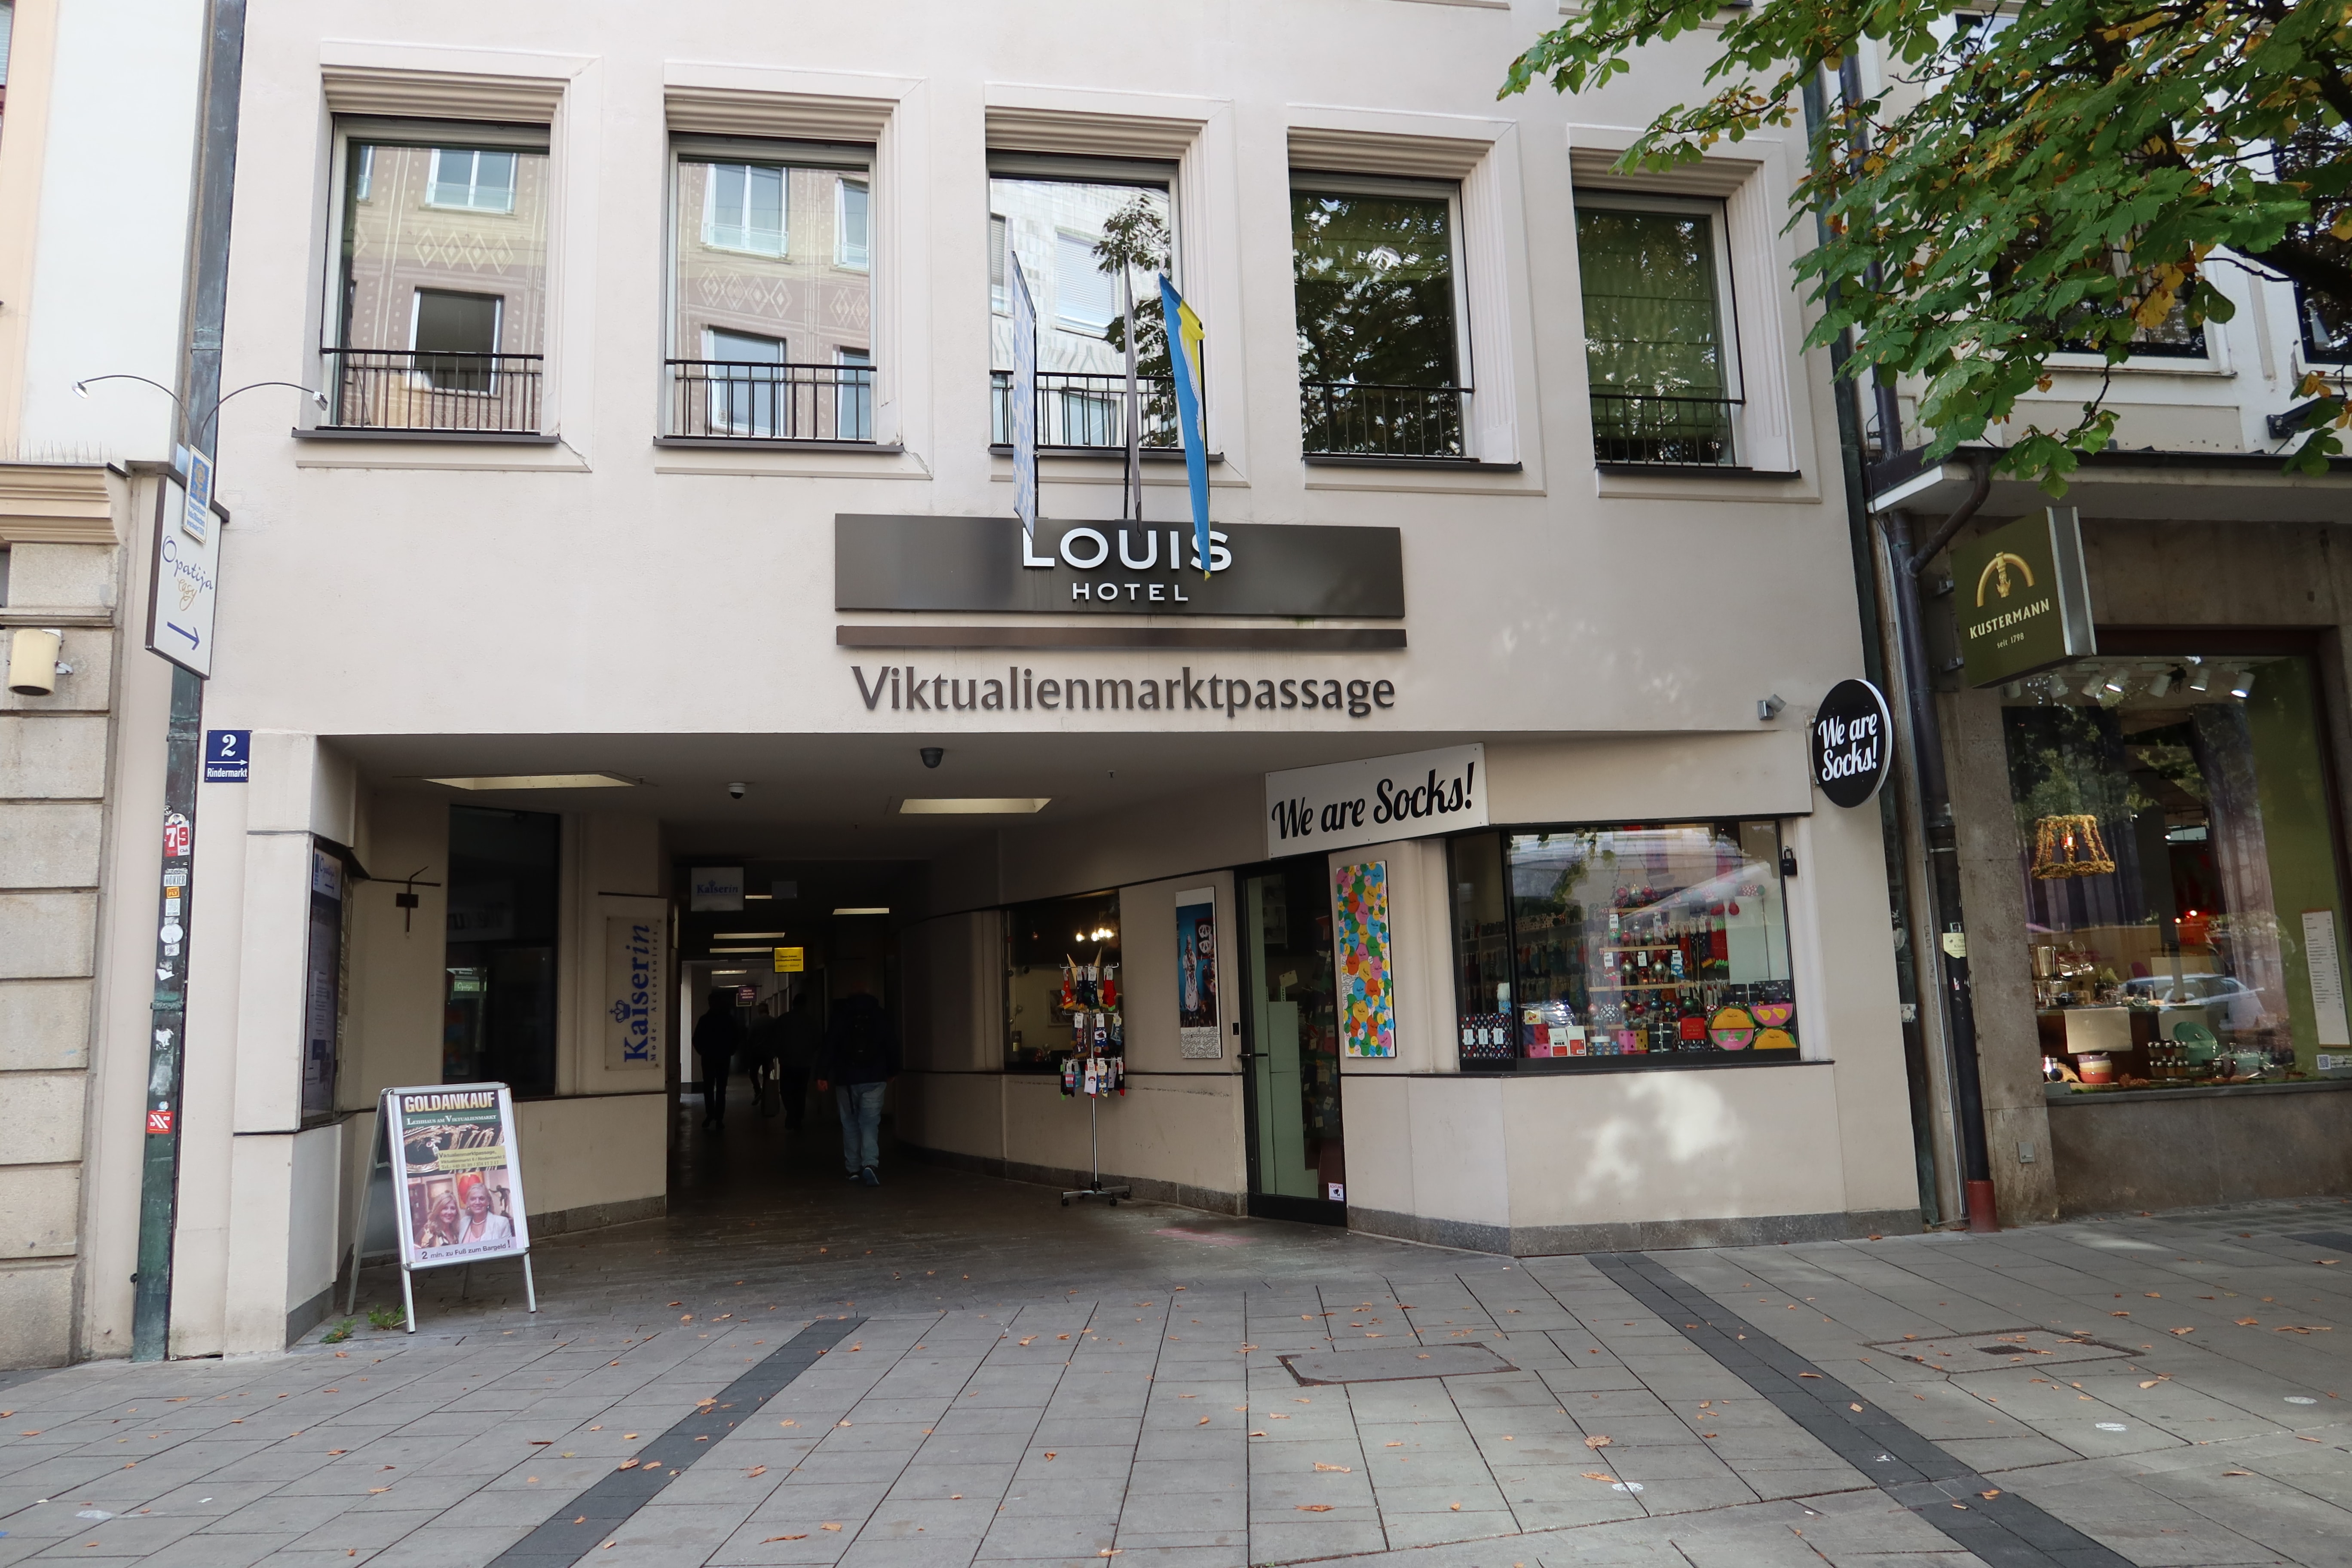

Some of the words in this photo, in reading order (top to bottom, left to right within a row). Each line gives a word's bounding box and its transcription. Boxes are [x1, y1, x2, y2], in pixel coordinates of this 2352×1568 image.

[1023, 527, 1232, 572] LOUIS
[162, 536, 214, 594] Opatija
[1072, 582, 1189, 601] HOTEL
[1969, 598, 2050, 640] KUSTERMANN
[1997, 639, 2008, 649] seit
[2010, 632, 2024, 644] 1798
[850, 666, 1396, 718] Viktualienmarktpassage
[221, 734, 236, 757] 2
[1818, 715, 1845, 749] We
[1849, 713, 1877, 741] are
[207, 768, 248, 778] Rindermarkt
[1822, 736, 1877, 781] Socks!
[1271, 796, 1314, 840] We
[1320, 798, 1366, 833] are
[1373, 761, 1475, 824] Socks!
[166, 827, 189, 847] 79
[697, 884, 738, 894] Kaiserin
[624, 925, 650, 1063] Kaiserin
[404, 1092, 495, 1113] GOLDANKAUF
[421, 1251, 428, 1259] 2
[483, 1243, 506, 1252] Bargeld
[507, 1239, 511, 1248] !
